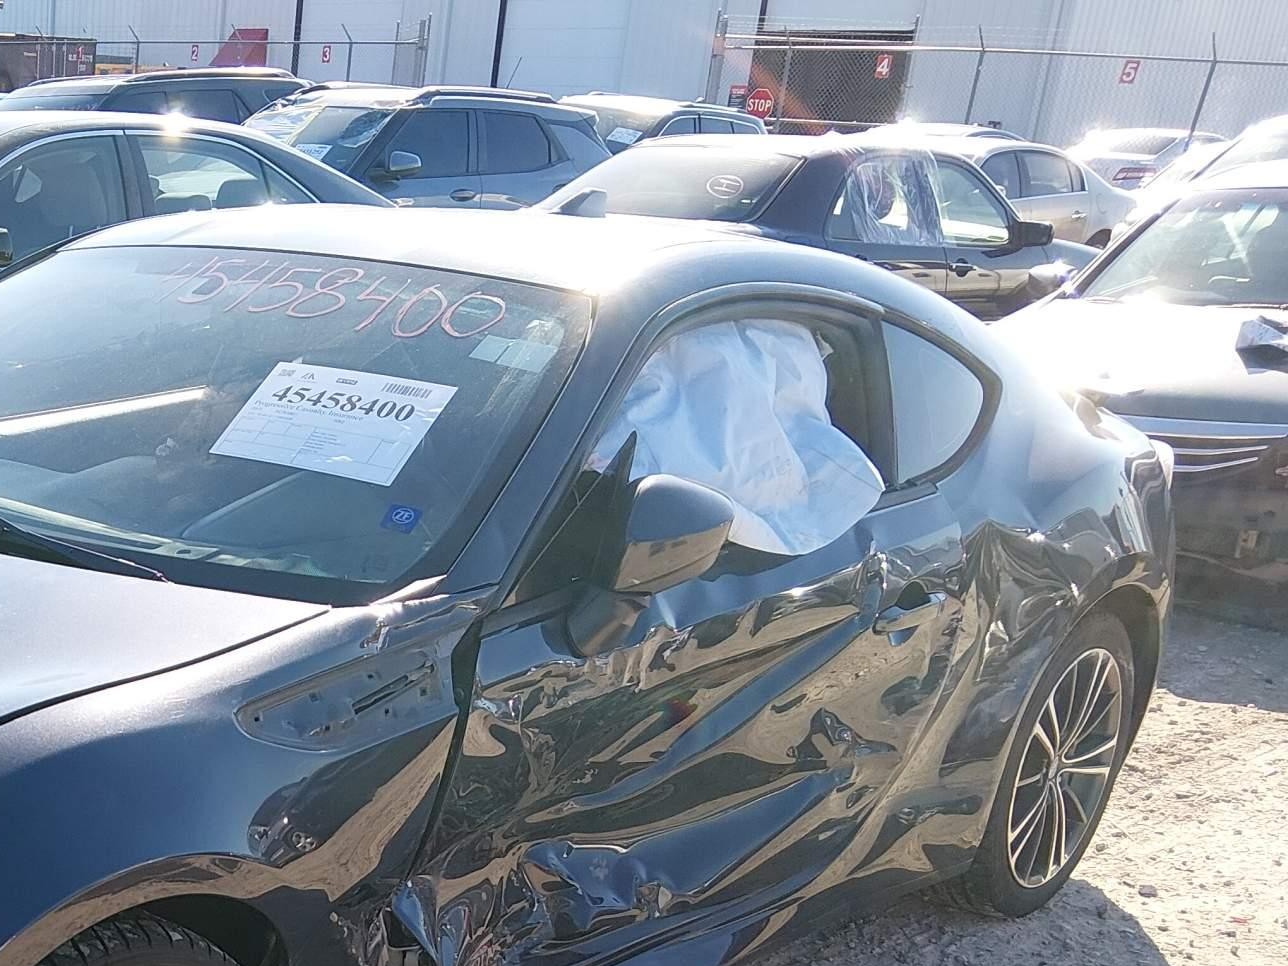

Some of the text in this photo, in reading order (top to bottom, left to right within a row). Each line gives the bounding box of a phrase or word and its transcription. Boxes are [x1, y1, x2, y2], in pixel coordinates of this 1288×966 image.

[191, 47, 198, 60] 2
[323, 47, 330, 61] 3
[876, 58, 889, 75] 4
[1122, 62, 1138, 81] 5
[748, 99, 772, 112] STOP
[160, 256, 505, 337] 45458400
[272, 385, 416, 422] 45458400
